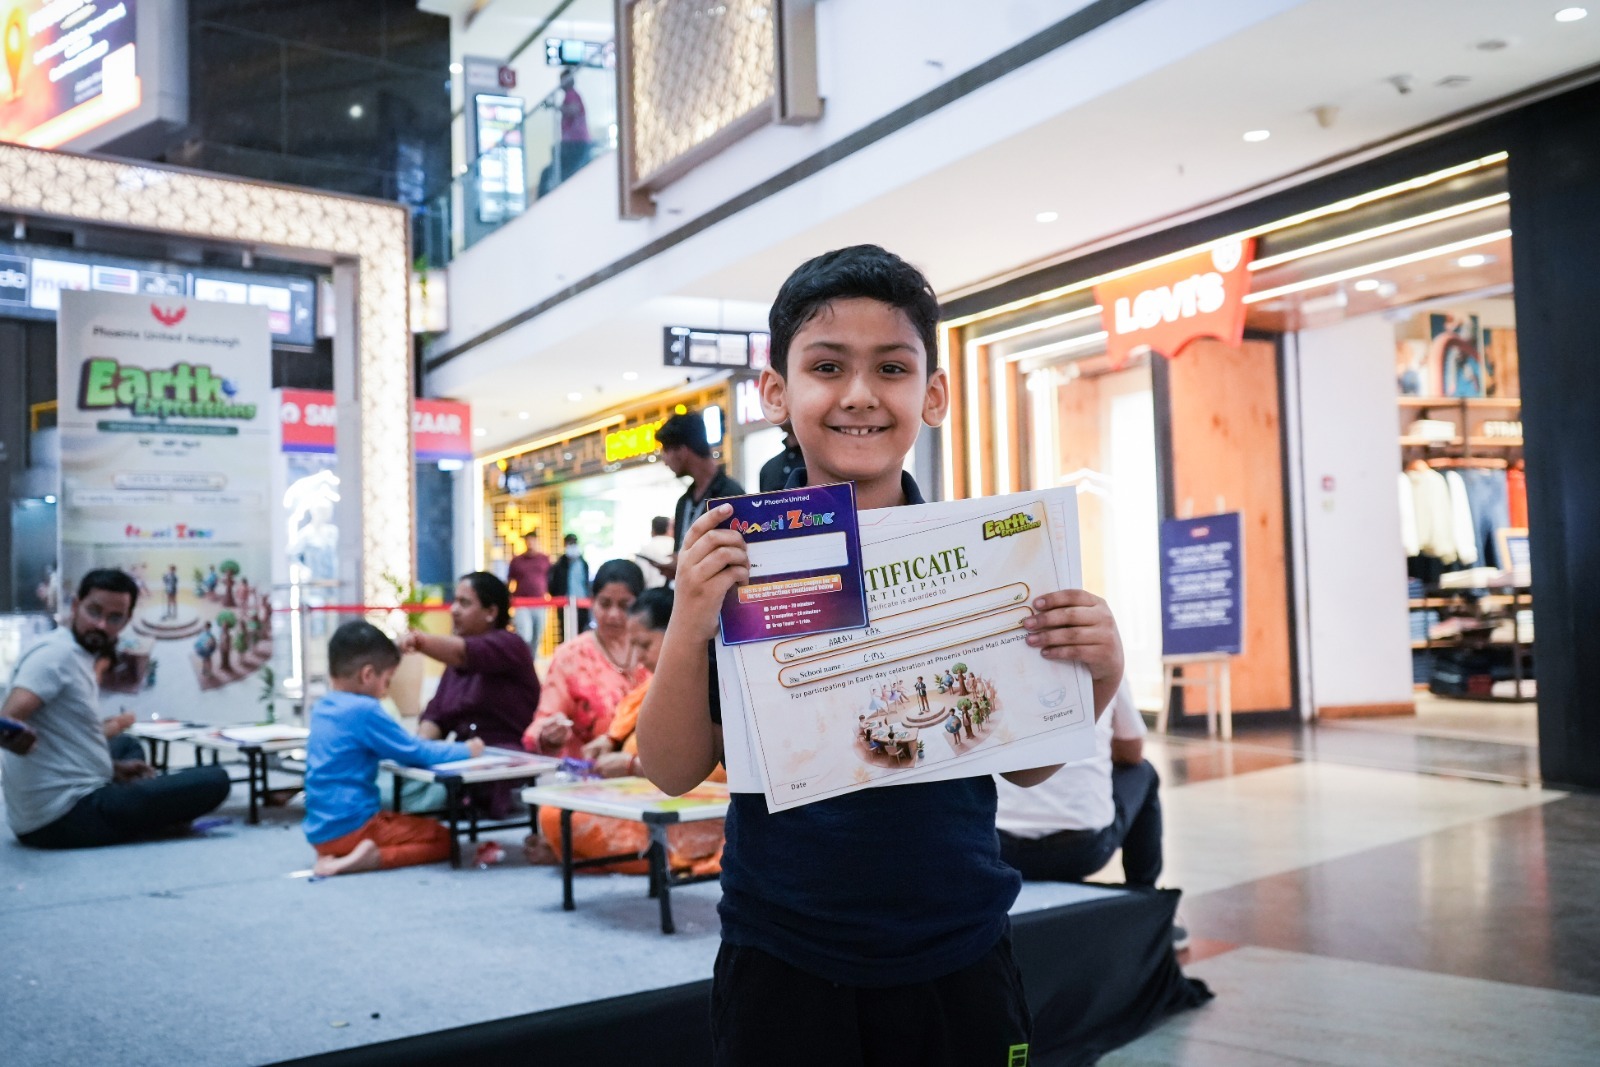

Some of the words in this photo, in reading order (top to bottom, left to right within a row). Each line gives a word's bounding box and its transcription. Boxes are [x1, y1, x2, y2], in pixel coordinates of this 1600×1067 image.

[80, 357, 224, 411] Earth
[412, 411, 461, 435] ZAAR
[764, 497, 788, 506] Phoenix
[789, 494, 810, 503] United
[730, 515, 784, 534] Masti
[786, 509, 835, 529] Zone
[983, 512, 1029, 540] Earth
[865, 546, 968, 592] TIFICATE
[870, 568, 978, 603] RTICIPATION
[867, 599, 899, 612] ertificate
[908, 590, 938, 603] awarded
[799, 667, 822, 677] School
[803, 680, 846, 697] participating
[848, 677, 855, 685] in
[855, 673, 874, 683] Earth
[875, 669, 887, 679] day
[888, 662, 926, 675] celebration
[935, 652, 961, 663] Phoenix
[962, 645, 984, 655] United
[986, 641, 999, 650] Mall
[1043, 709, 1073, 722] Signature
[790, 782, 807, 790] Date
